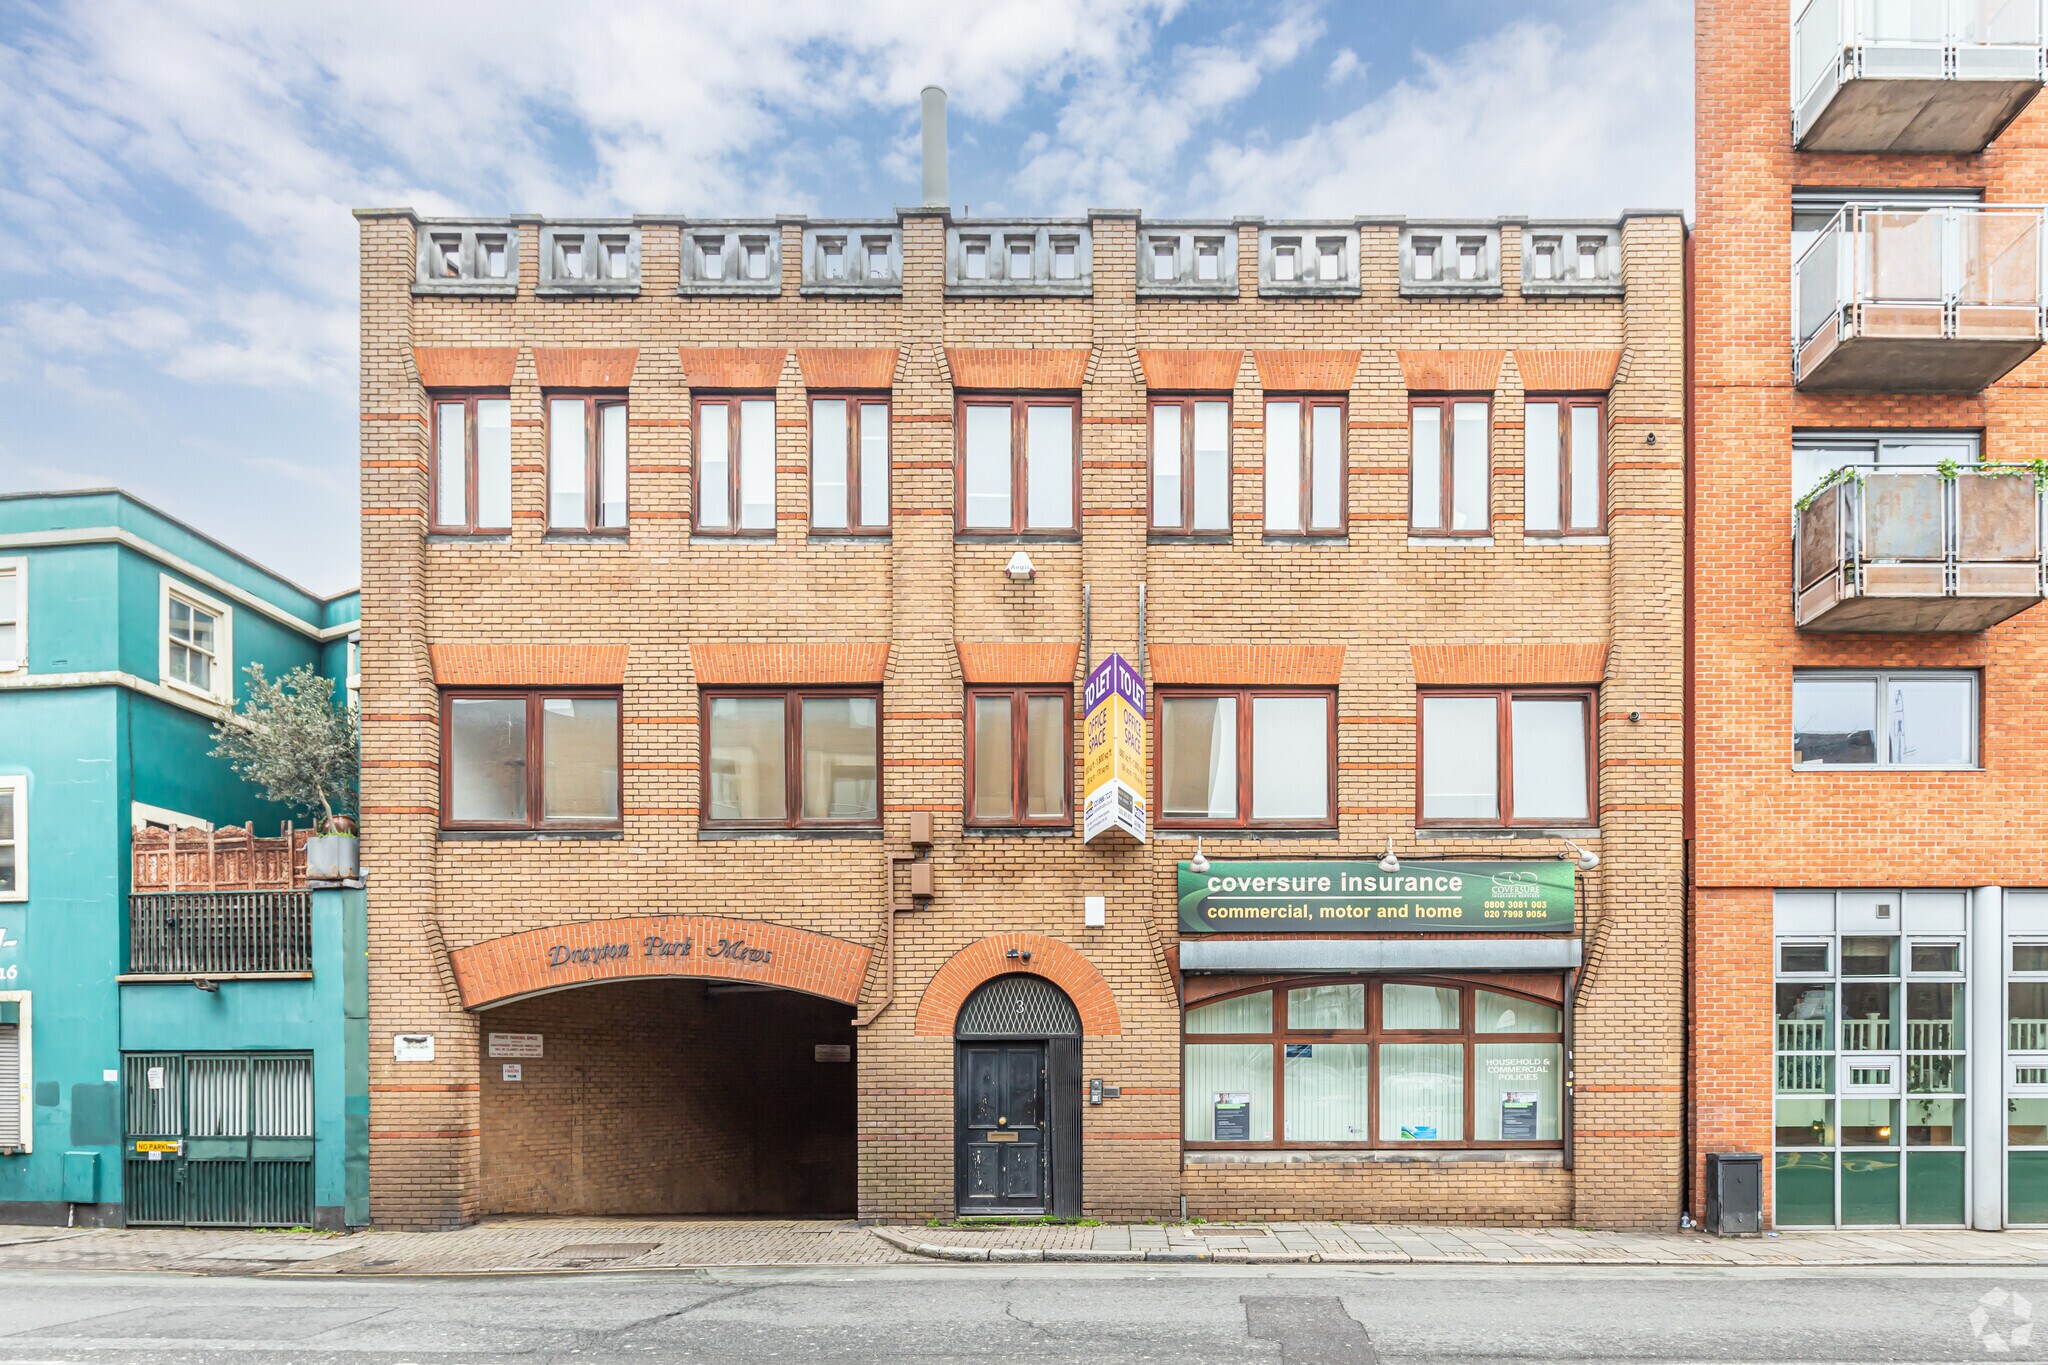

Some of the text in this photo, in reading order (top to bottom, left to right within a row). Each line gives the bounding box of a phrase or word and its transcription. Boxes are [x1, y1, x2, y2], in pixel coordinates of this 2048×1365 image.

[1085, 665, 1111, 710] TO LET
[1119, 665, 1145, 710] TO LET
[1088, 707, 1107, 737] OFFICE
[1123, 708, 1141, 738] OFFICE
[1089, 727, 1106, 755] SPACE
[1125, 728, 1141, 755] SPACE
[1207, 872, 1463, 892] coversure insurance
[1491, 885, 1540, 894] COVERSURE
[1207, 904, 1463, 920] commercial, motor and home
[1484, 900, 1505, 909] 0800
[1531, 900, 1547, 909] 003
[1484, 910, 1500, 918] 020
[1526, 910, 1547, 918] 9054
[548, 936, 773, 967] Drayton Park Mews
[1016, 999, 1024, 1013] 3
[1486, 1058, 1541, 1066] HOUSEHOLD
[1498, 1073, 1538, 1081] POLICIES
